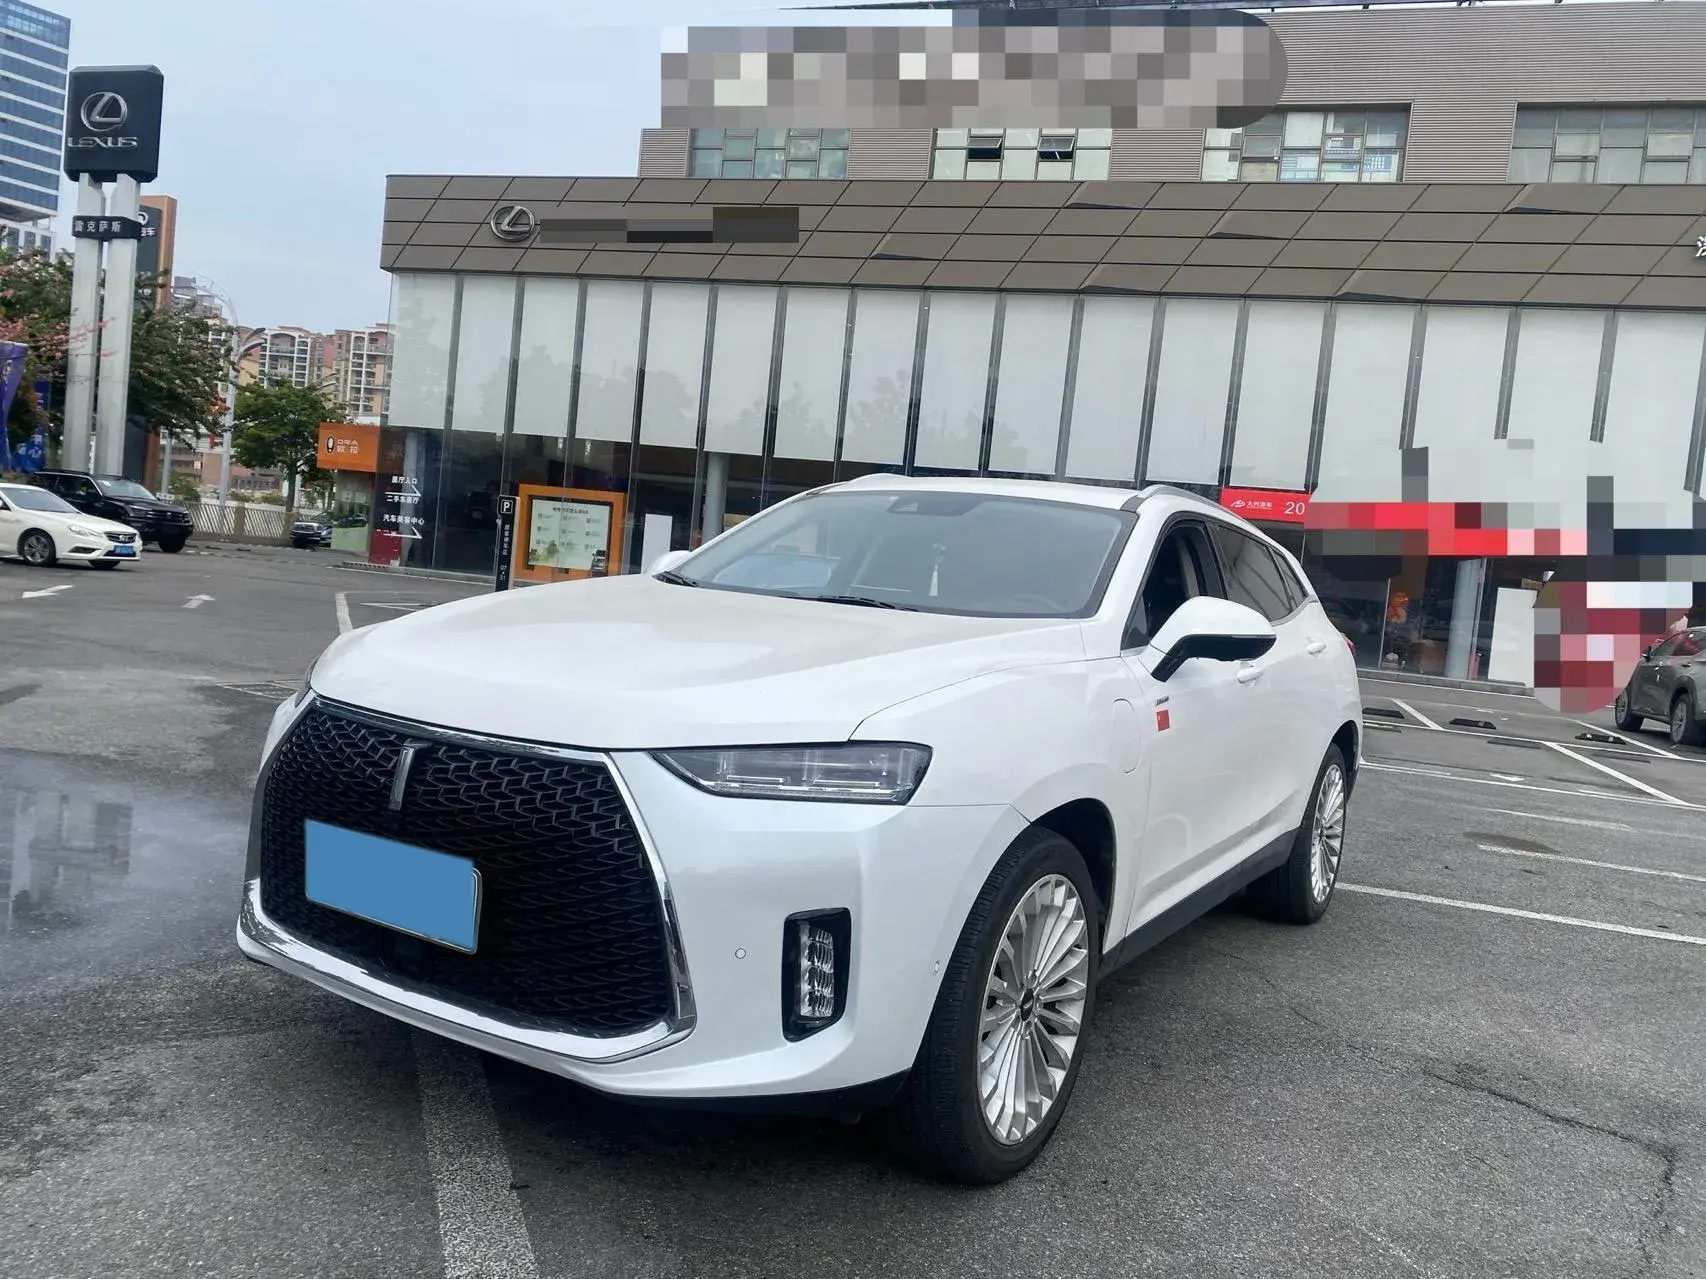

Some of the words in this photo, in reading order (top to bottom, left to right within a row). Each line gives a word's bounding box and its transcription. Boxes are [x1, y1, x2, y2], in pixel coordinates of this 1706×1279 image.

[67, 136, 138, 149] LEXUS
[74, 220, 121, 232] 雷克萨斯
[391, 475, 418, 485] 展厅入口
[386, 495, 419, 504] 二手车展厅
[503, 501, 511, 512] P
[1283, 501, 1306, 515] 20
[382, 513, 425, 526] 汽车美容中心
